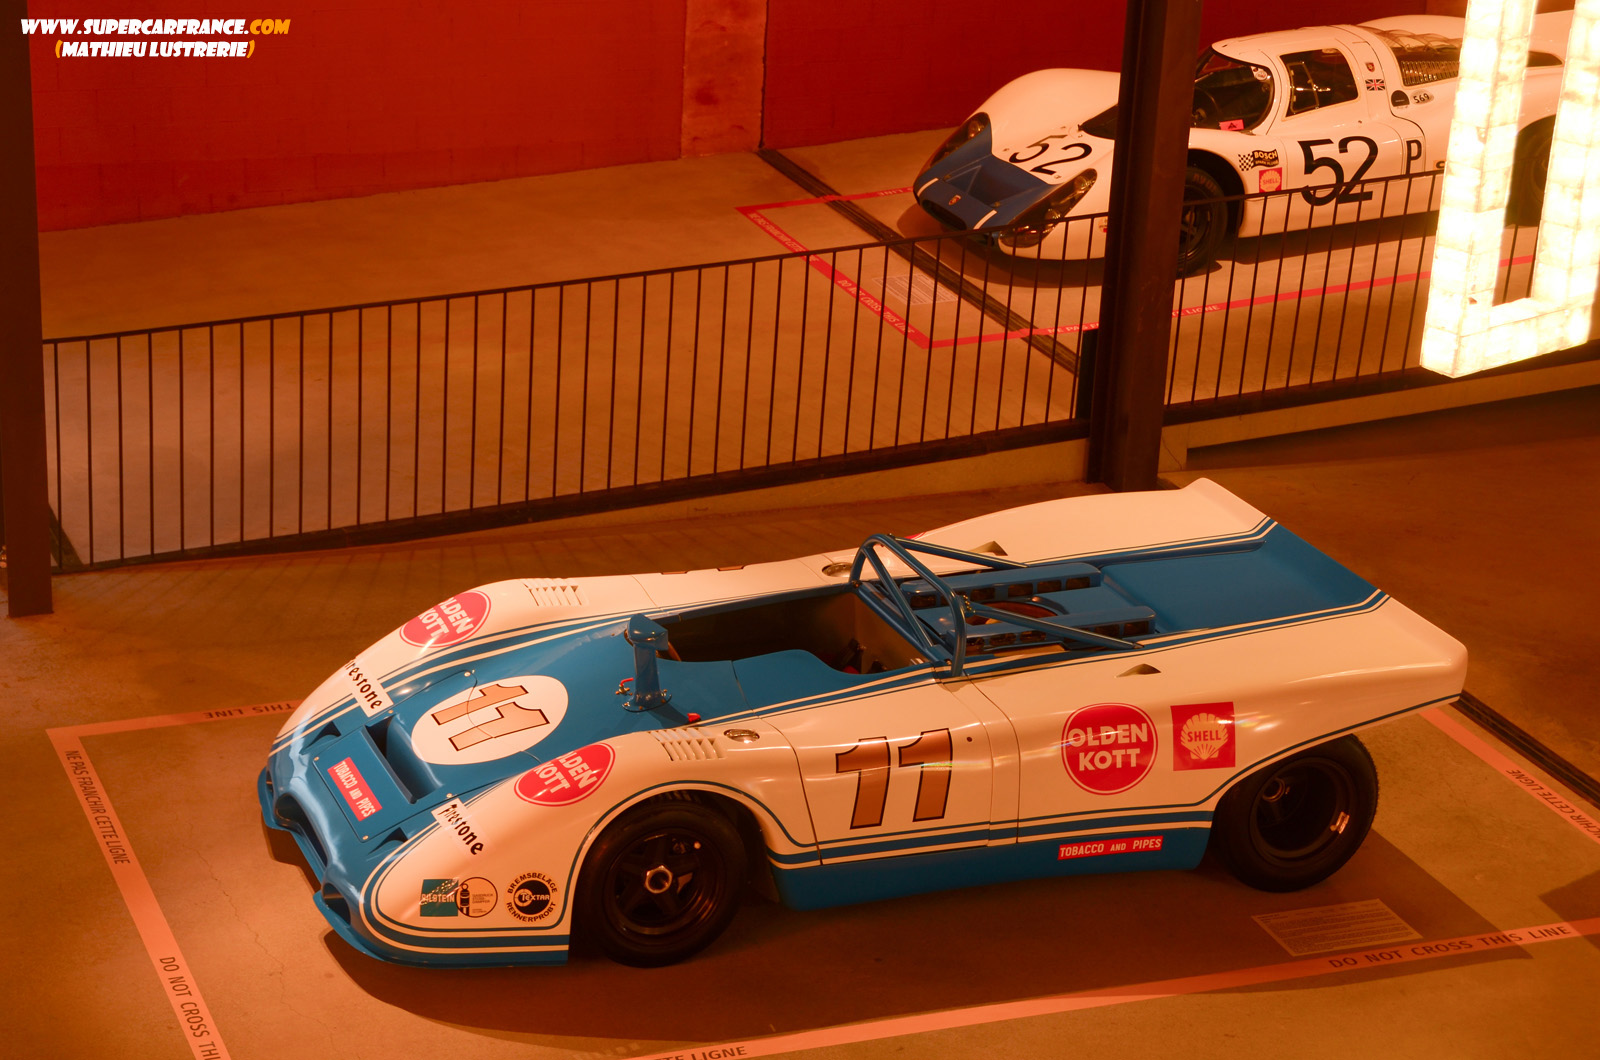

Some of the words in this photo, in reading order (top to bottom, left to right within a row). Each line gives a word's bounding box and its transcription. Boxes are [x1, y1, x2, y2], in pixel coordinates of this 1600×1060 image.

[1413, 93, 1430, 104] 569
[1008, 134, 1093, 175] 52
[1254, 151, 1278, 160] BOSCH
[1405, 139, 1422, 175] P
[1297, 135, 1379, 207] 52
[438, 596, 475, 635] LDEN
[345, 660, 383, 710] irestone
[431, 683, 550, 752] 11
[1067, 722, 1149, 748] OLDEN
[1187, 729, 1222, 743] SHELL
[65, 750, 83, 760] NE
[70, 760, 89, 775] PAS
[1078, 747, 1141, 772] KOTT
[333, 760, 358, 789] TOBACCO
[556, 750, 598, 790] LDEN
[835, 727, 953, 830] 11
[76, 776, 107, 815] FRANCHIR
[94, 815, 119, 839] CETTE
[437, 803, 484, 856] Firestone
[106, 840, 131, 865] LIGNE
[1060, 843, 1105, 858] TOBACCO
[1110, 843, 1127, 852] AND
[1132, 838, 1162, 850] PIPES
[1329, 956, 1358, 969] DO
[1365, 949, 1404, 963] NOT
[1410, 940, 1473, 956] CROSS
[1479, 932, 1523, 947] THIS
[1527, 926, 1572, 940] LINE
[160, 956, 180, 972] DO
[168, 975, 192, 997] NOT
[180, 1002, 210, 1038] CROSS
[198, 1041, 222, 1060] THI
